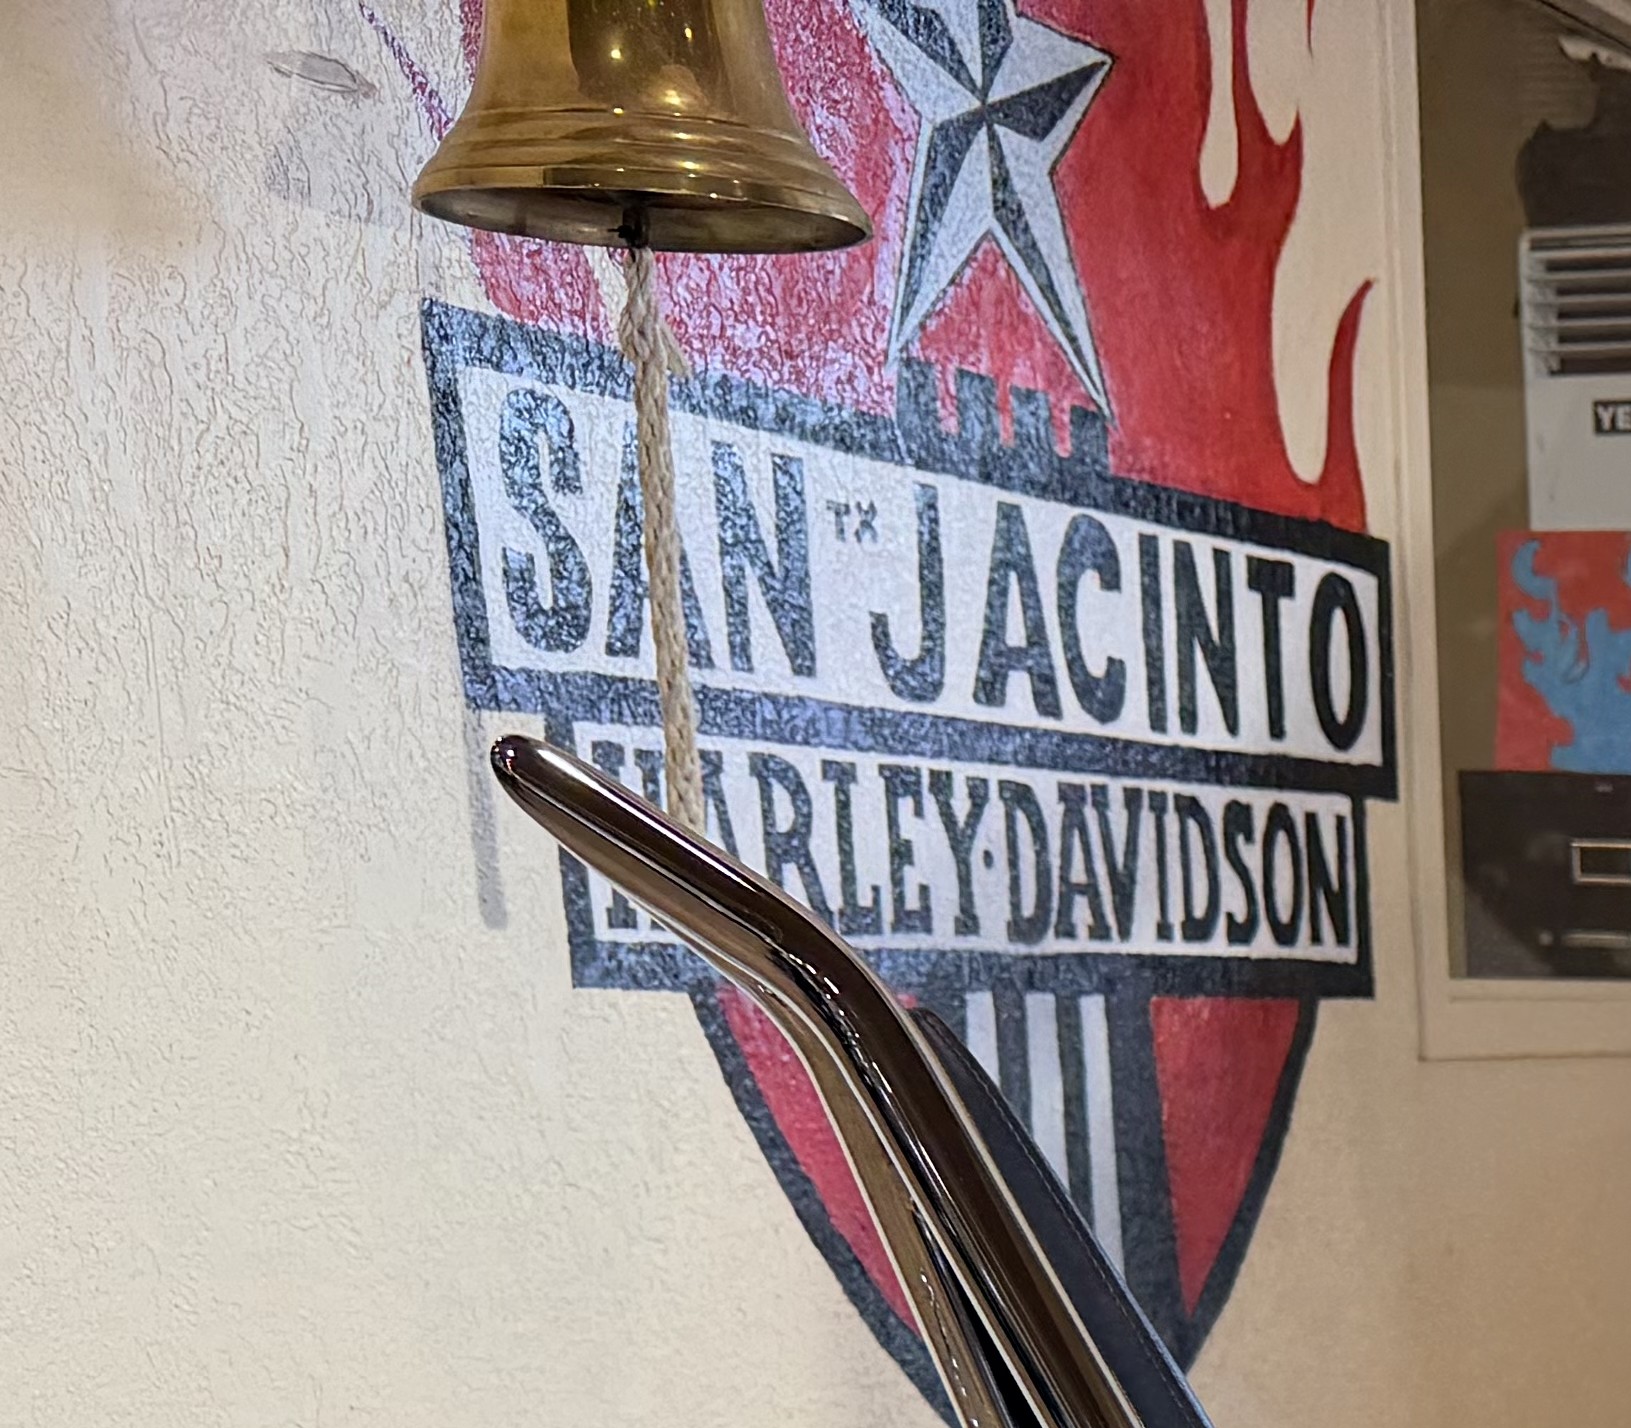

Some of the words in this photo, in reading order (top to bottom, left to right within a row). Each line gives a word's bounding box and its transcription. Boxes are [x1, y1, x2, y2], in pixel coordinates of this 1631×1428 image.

[492, 388, 817, 678] SAN
[871, 482, 1370, 753] JACINTO
[826, 499, 878, 545] TX
